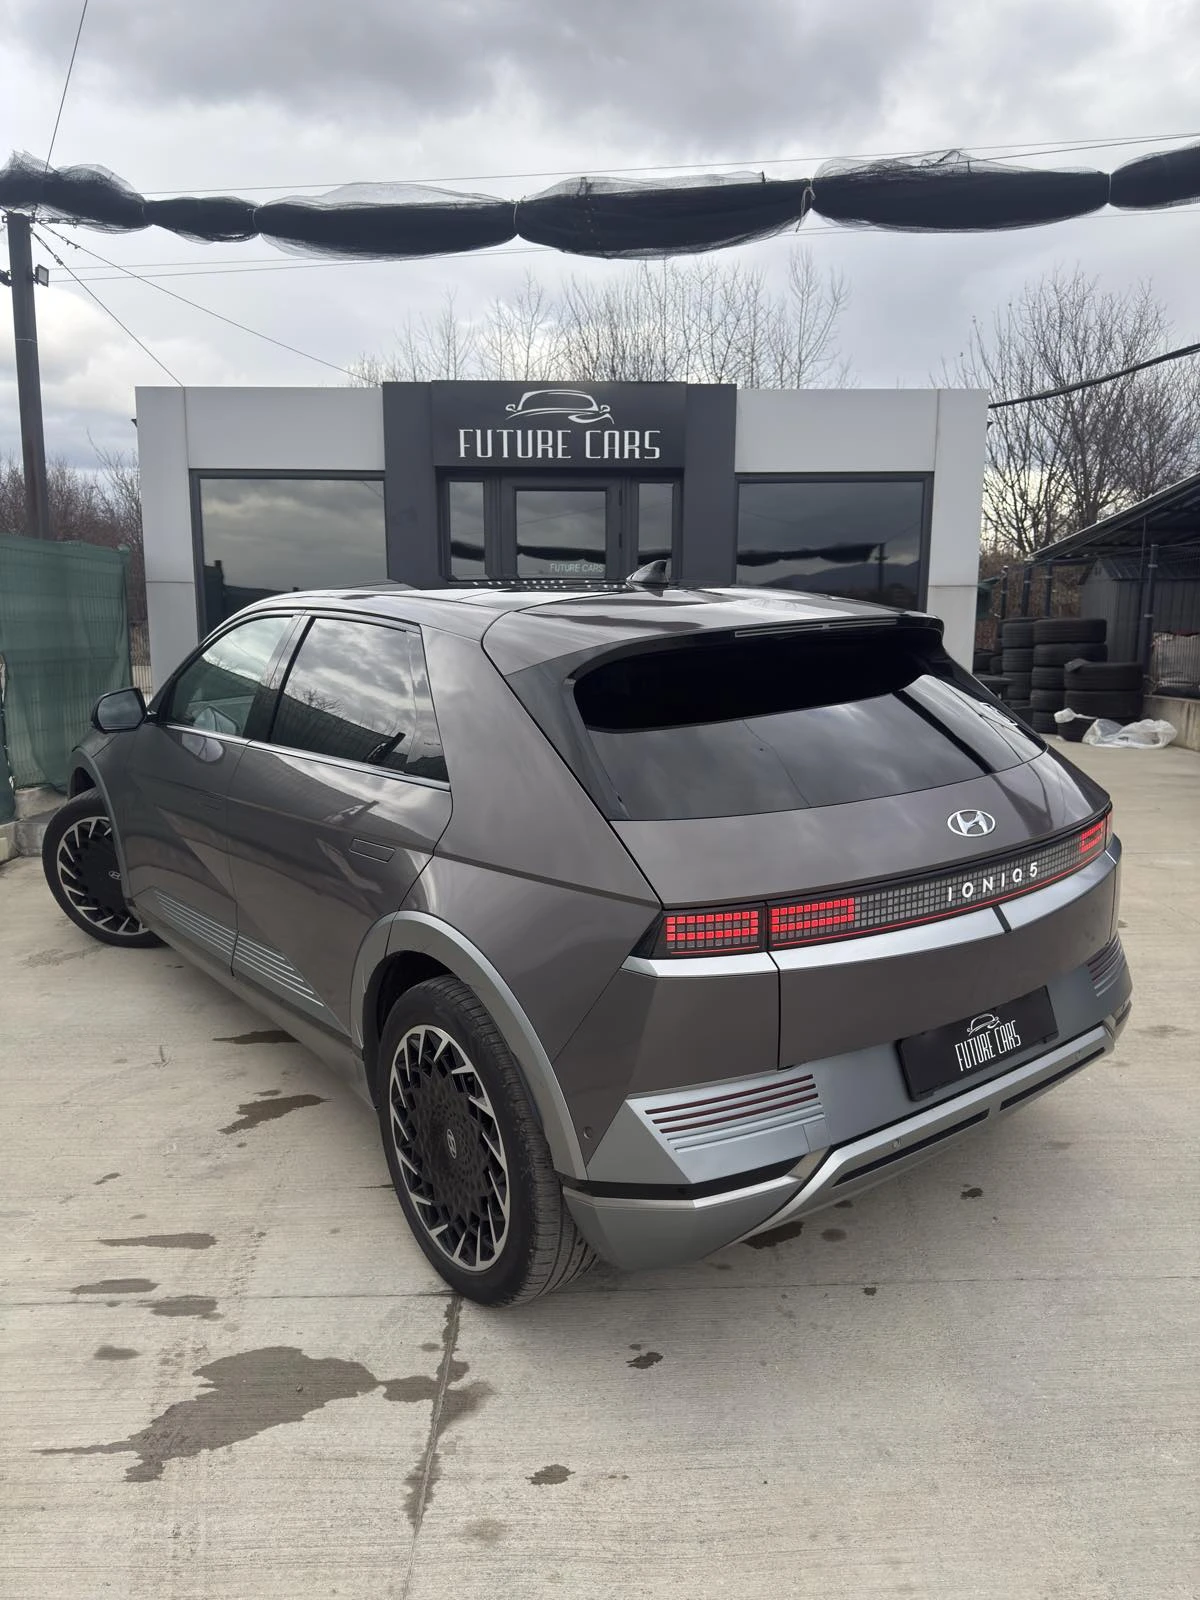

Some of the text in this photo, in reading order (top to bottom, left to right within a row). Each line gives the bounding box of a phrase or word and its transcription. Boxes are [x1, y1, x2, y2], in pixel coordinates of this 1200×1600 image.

[458, 429, 662, 460] FUTURE CARS
[549, 563, 604, 573] FUTURE CARS
[954, 1019, 1022, 1072] FUTURE CARS
